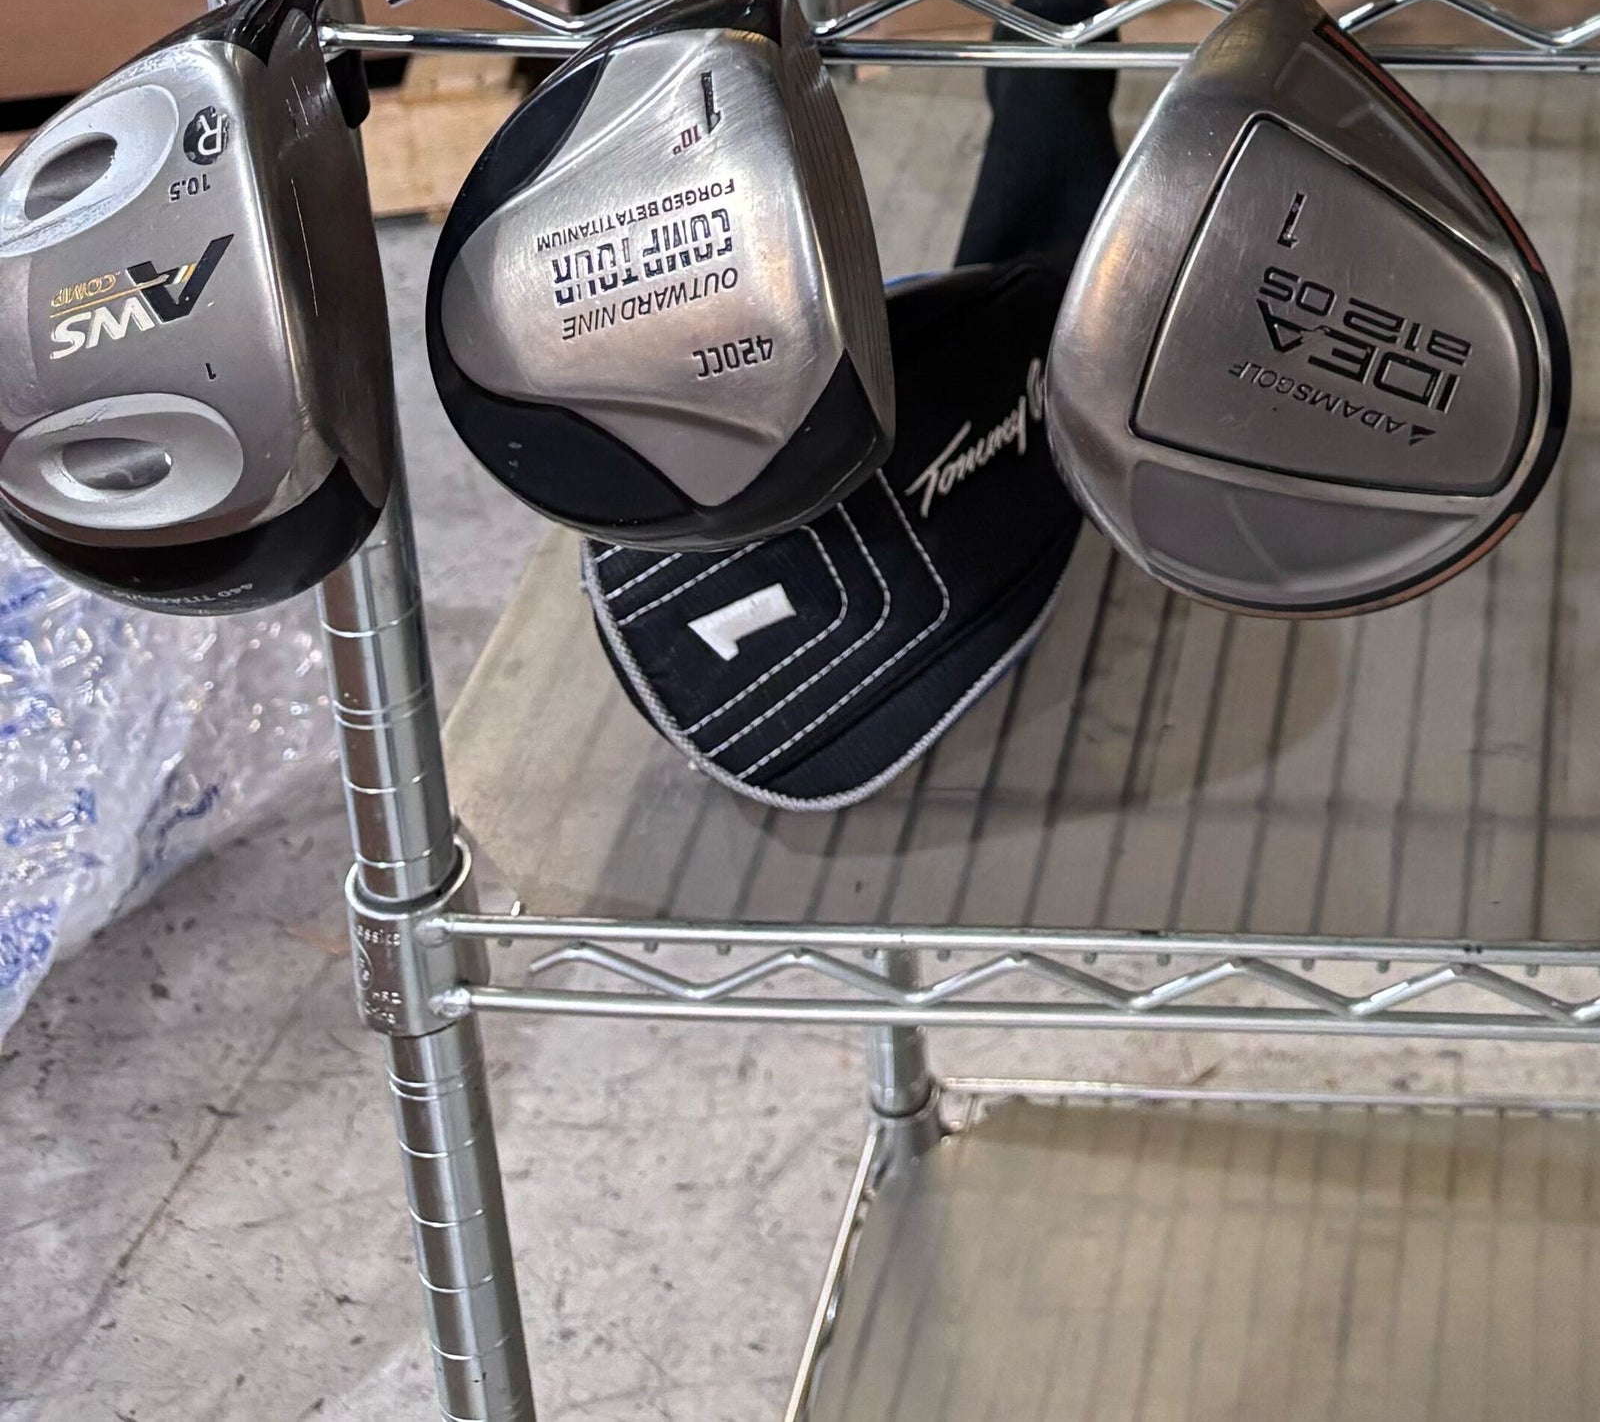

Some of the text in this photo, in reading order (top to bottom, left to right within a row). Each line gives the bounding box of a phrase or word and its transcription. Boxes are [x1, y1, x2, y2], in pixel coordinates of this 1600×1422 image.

[701, 71, 722, 133] 1
[168, 173, 211, 202] 10.5
[535, 179, 734, 251] FORGED BETA TITANIUM
[1278, 192, 1304, 250] 1
[49, 233, 235, 361] AWS
[561, 267, 738, 339] OUTWARD NINE
[1257, 264, 1336, 318] OS
[204, 362, 217, 381] 1
[692, 334, 774, 378] 420CC
[1254, 299, 1459, 416] IDEA
[1228, 361, 1407, 433] ADAMSGOLF
[905, 409, 1030, 518] Tommy
[688, 583, 794, 663] 1
